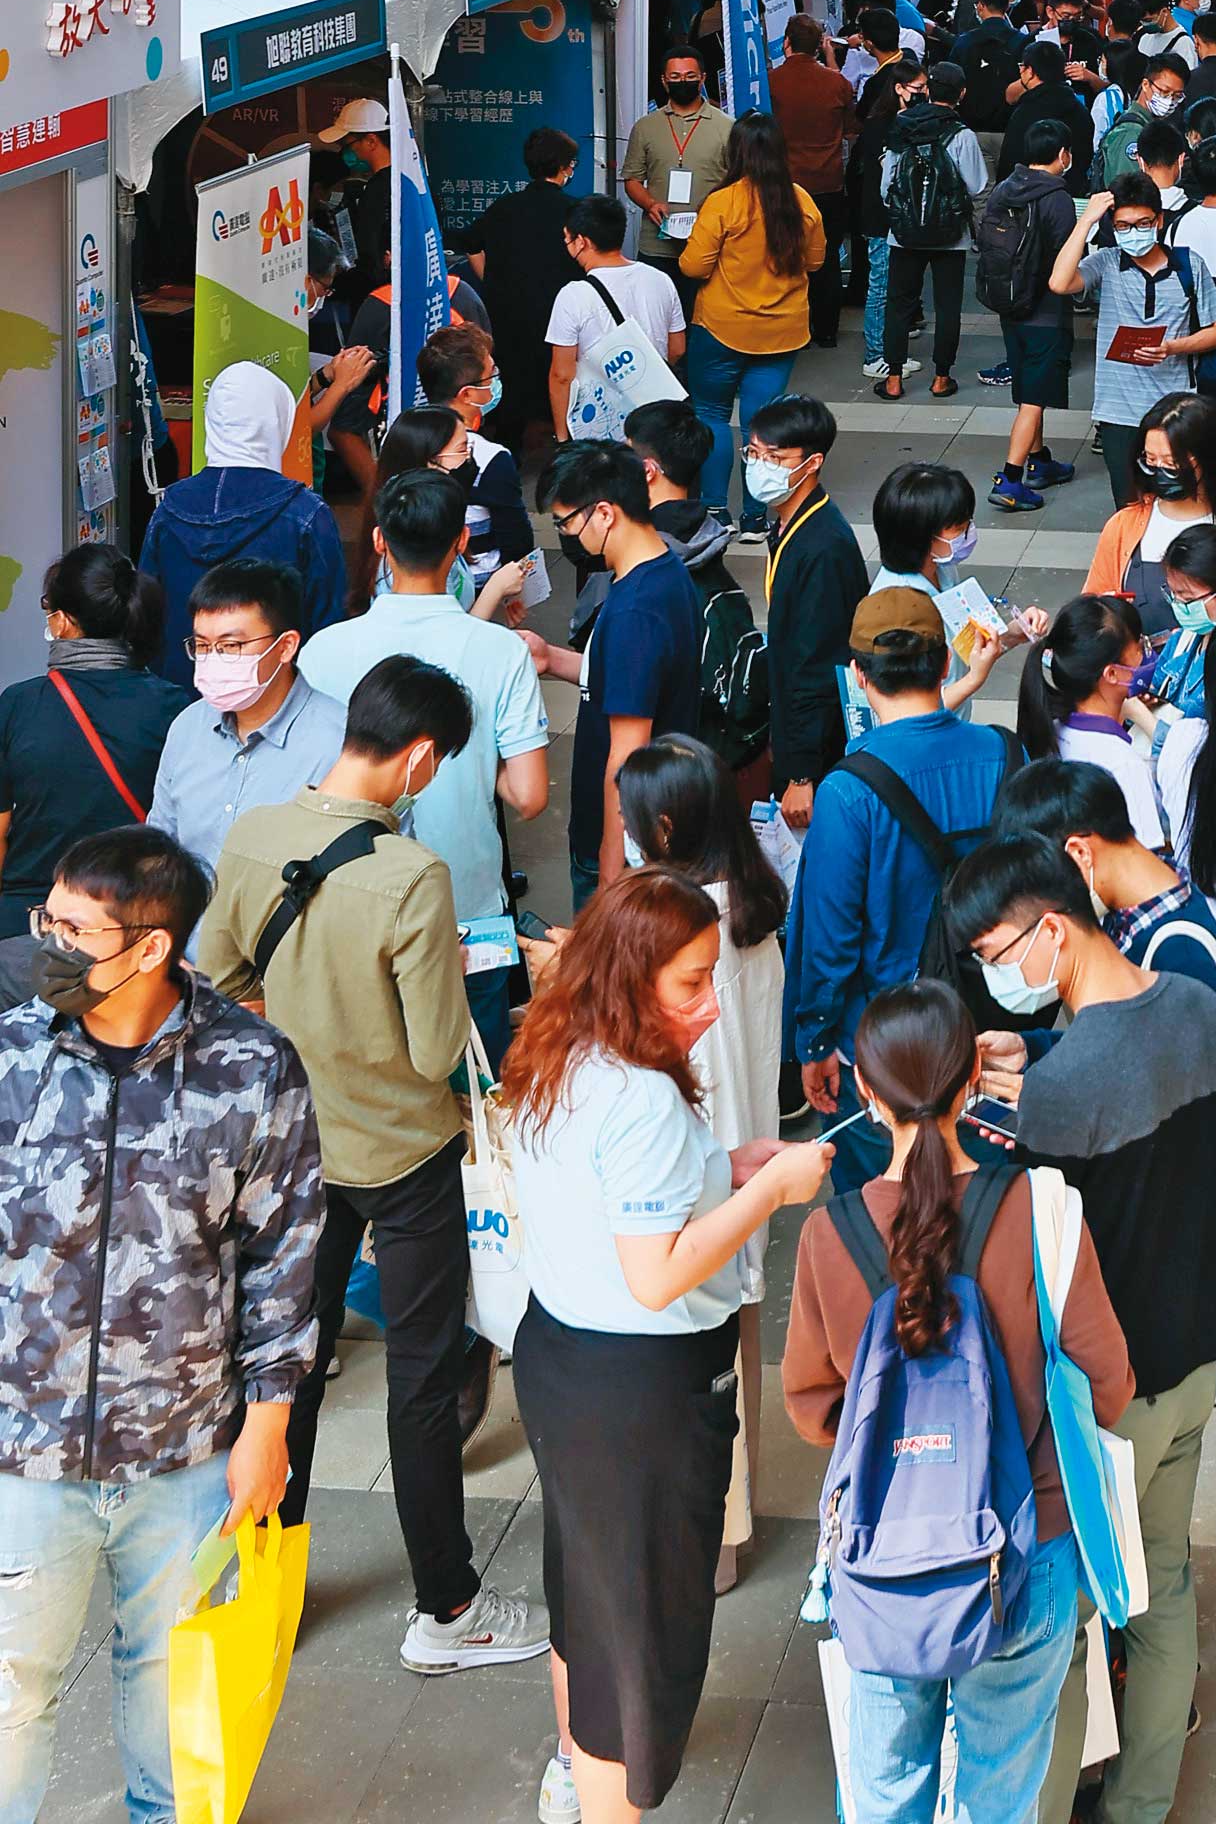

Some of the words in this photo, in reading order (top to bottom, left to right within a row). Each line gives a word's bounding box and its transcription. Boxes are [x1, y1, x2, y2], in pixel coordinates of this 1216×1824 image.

[266, 11, 357, 69] 旭聯教育科技集團
[211, 56, 229, 83] 49
[232, 107, 280, 123] AR/VR
[604, 350, 634, 378] AUO
[467, 1209, 509, 1239] UO
